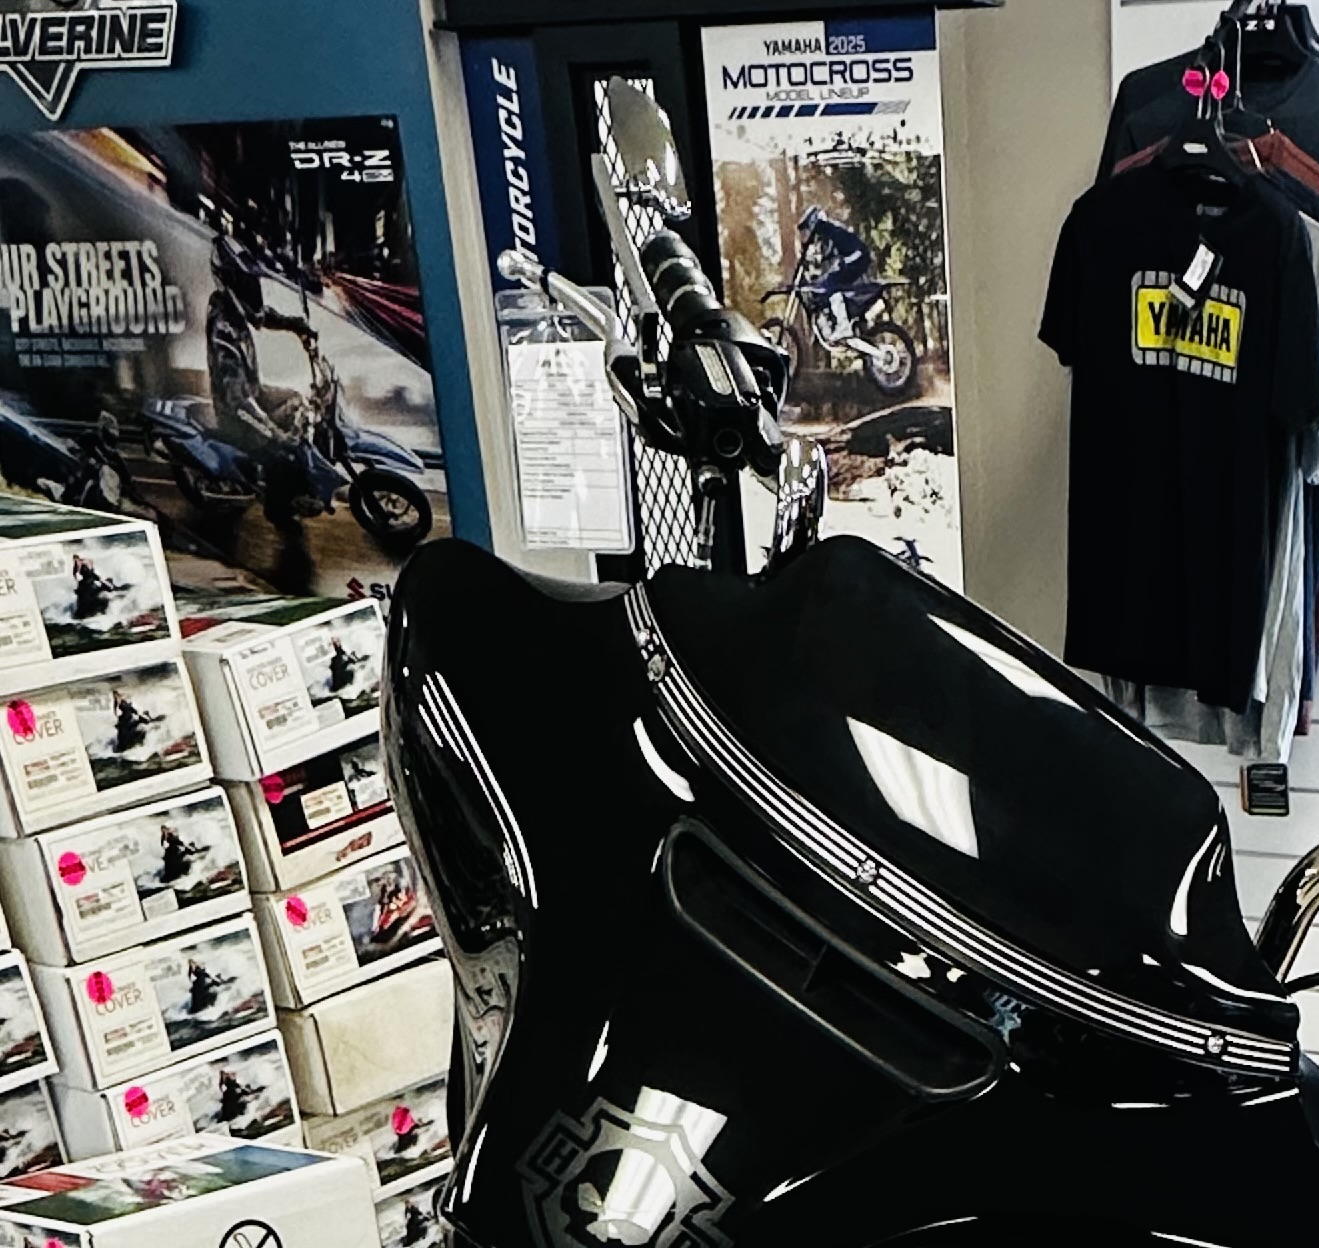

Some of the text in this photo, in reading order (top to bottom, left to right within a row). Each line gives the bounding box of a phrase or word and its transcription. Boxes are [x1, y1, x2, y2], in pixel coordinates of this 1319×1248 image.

[763, 34, 866, 56] YAMAHA 2025
[721, 56, 914, 91] MOTOCROSS
[766, 86, 870, 101] MODEL LINEUP
[290, 149, 392, 169] DR-Z
[491, 57, 541, 290] TORCYCLE
[45, 240, 162, 291] STREETS
[10, 284, 187, 334] PLAYGROUND
